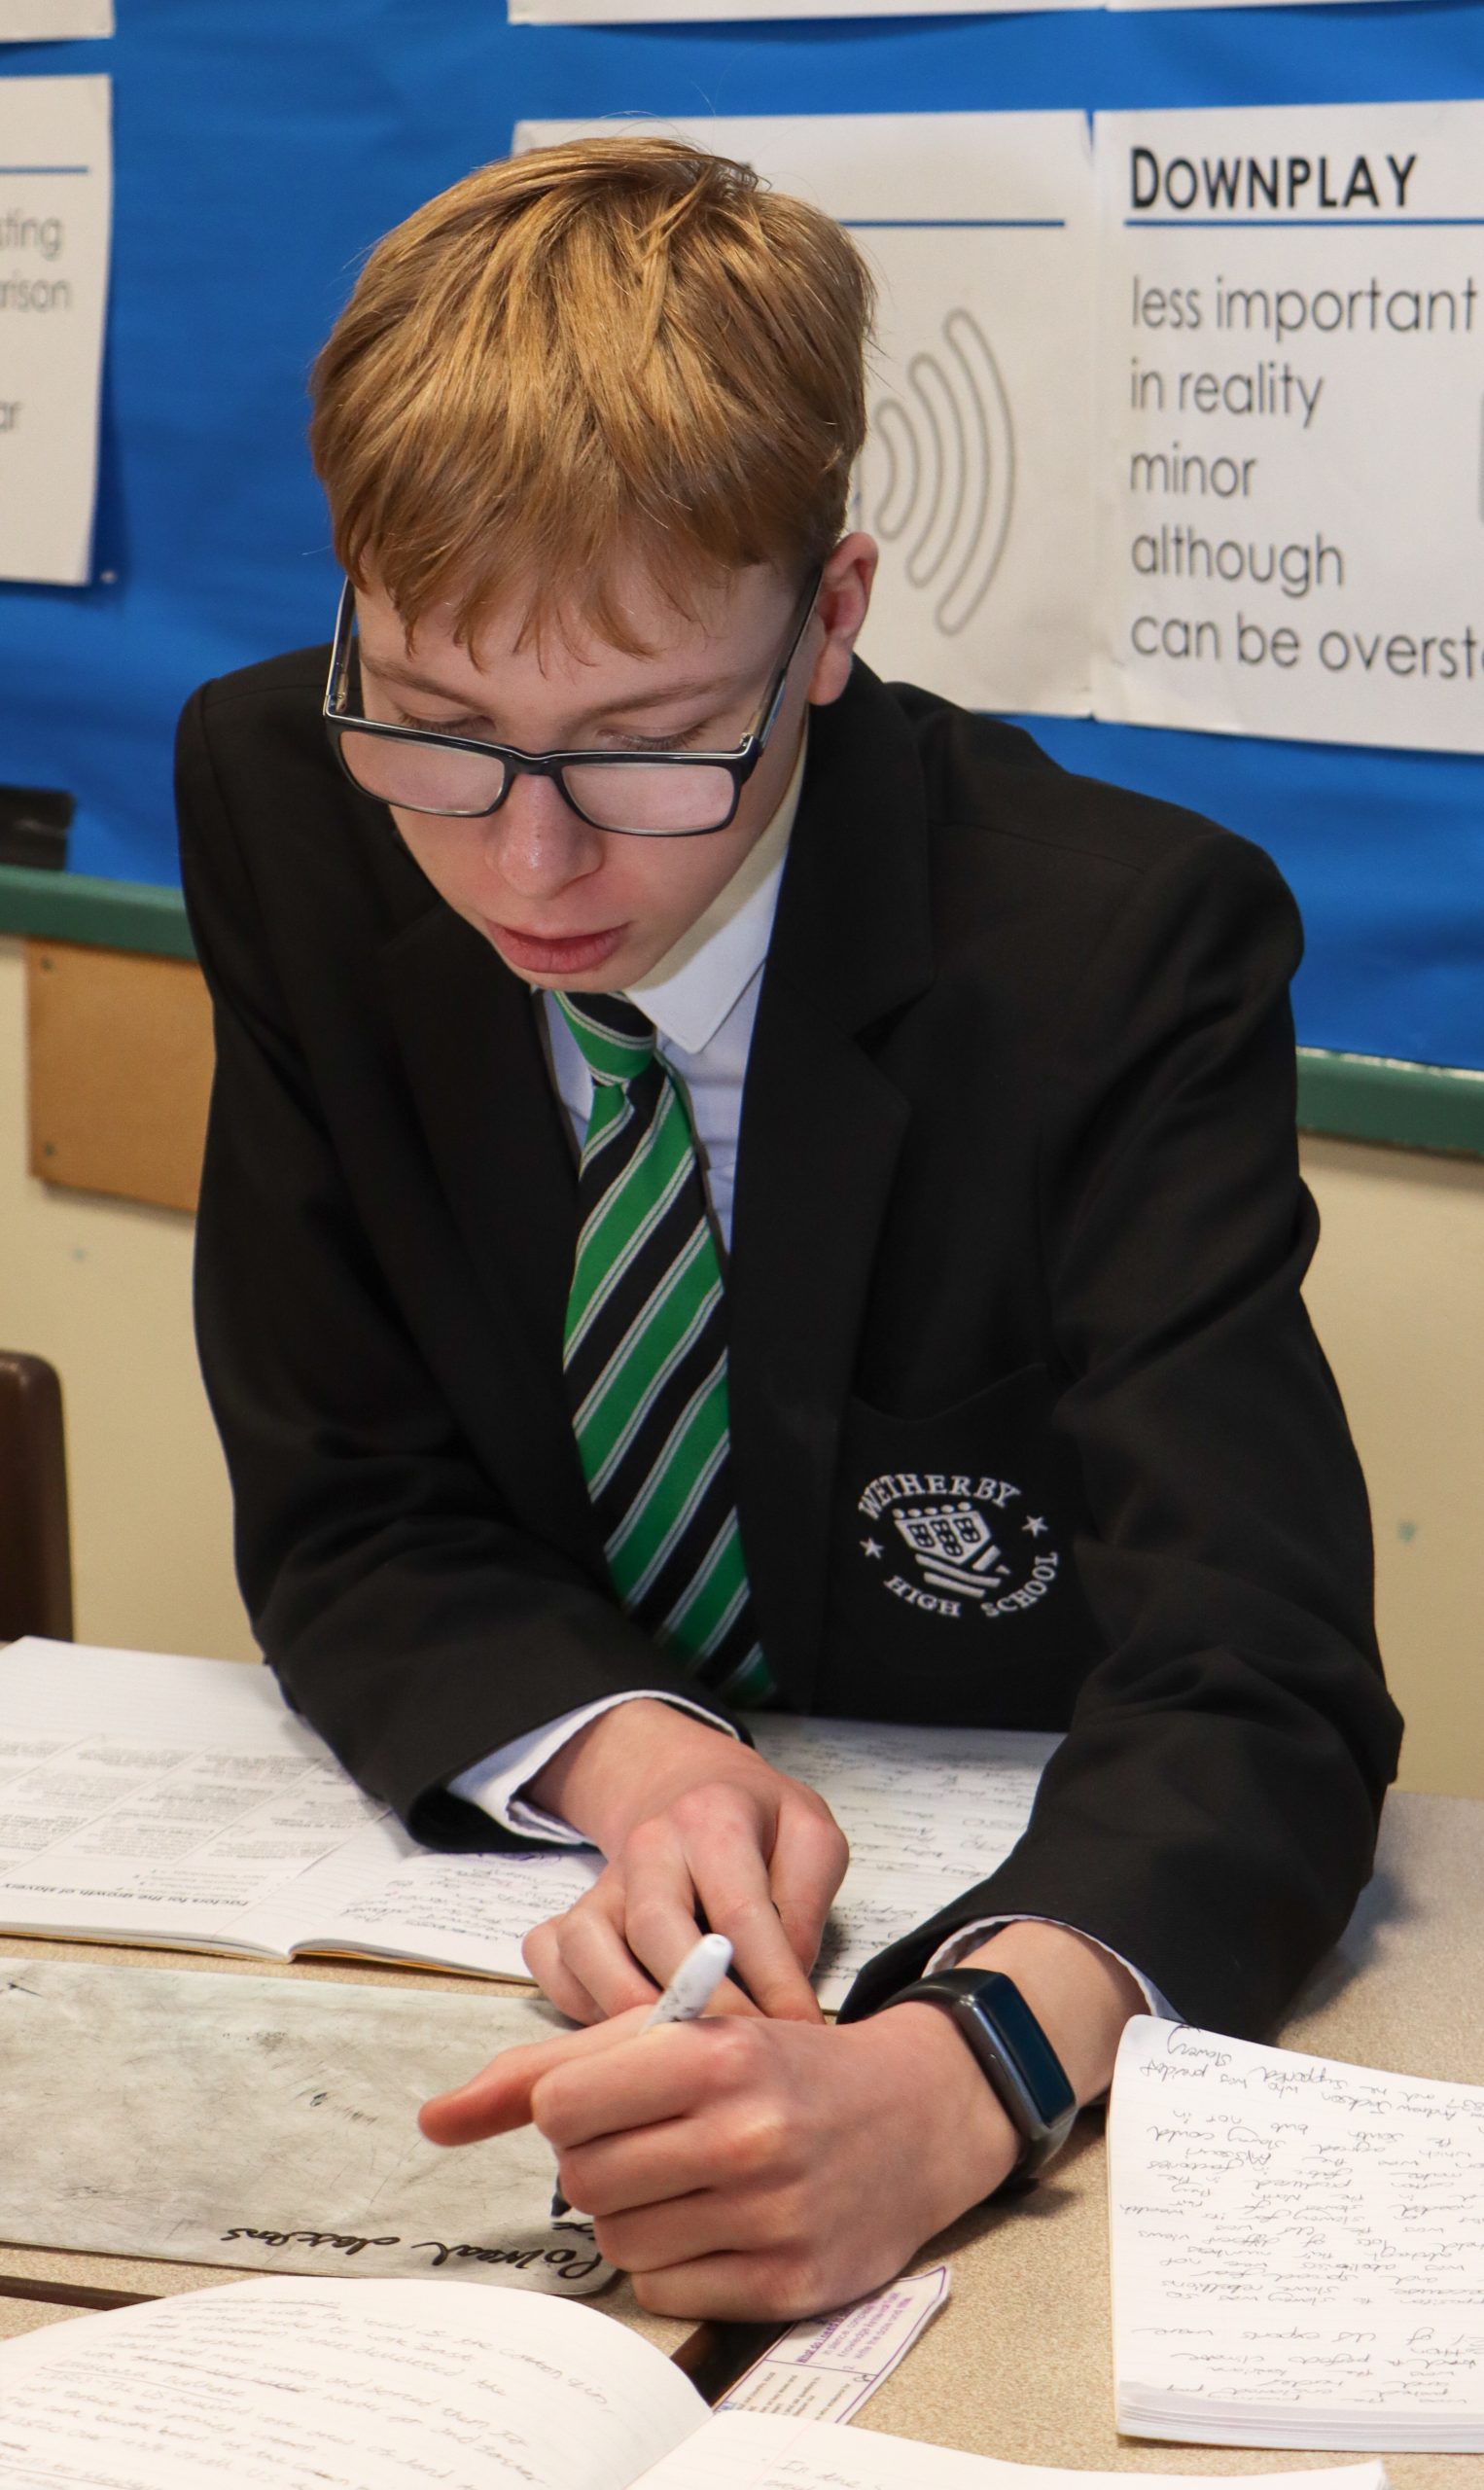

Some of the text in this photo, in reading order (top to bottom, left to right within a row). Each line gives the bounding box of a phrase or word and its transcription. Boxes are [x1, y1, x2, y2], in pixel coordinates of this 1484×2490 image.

[0, 207, 63, 261] ting
[0, 268, 72, 312] rison
[1131, 274, 1477, 343] less important
[1130, 356, 1324, 429] in reality
[1130, 441, 1257, 497] minor
[1131, 524, 1344, 598] although
[1131, 610, 1484, 680] can be overst
[858, 1474, 1021, 1520] WETHERBY
[883, 1551, 1059, 1618] HIGH SCHOOL
[2, 1882, 57, 1893] slavery
[79, 1890, 133, 1900] growth
[191, 1898, 249, 1907] Factors
[1267, 2081, 1299, 2099] who
[1395, 2104, 1457, 2121] Andrew
[1147, 2125, 1216, 2143] could
[1405, 2327, 1434, 2345] of
